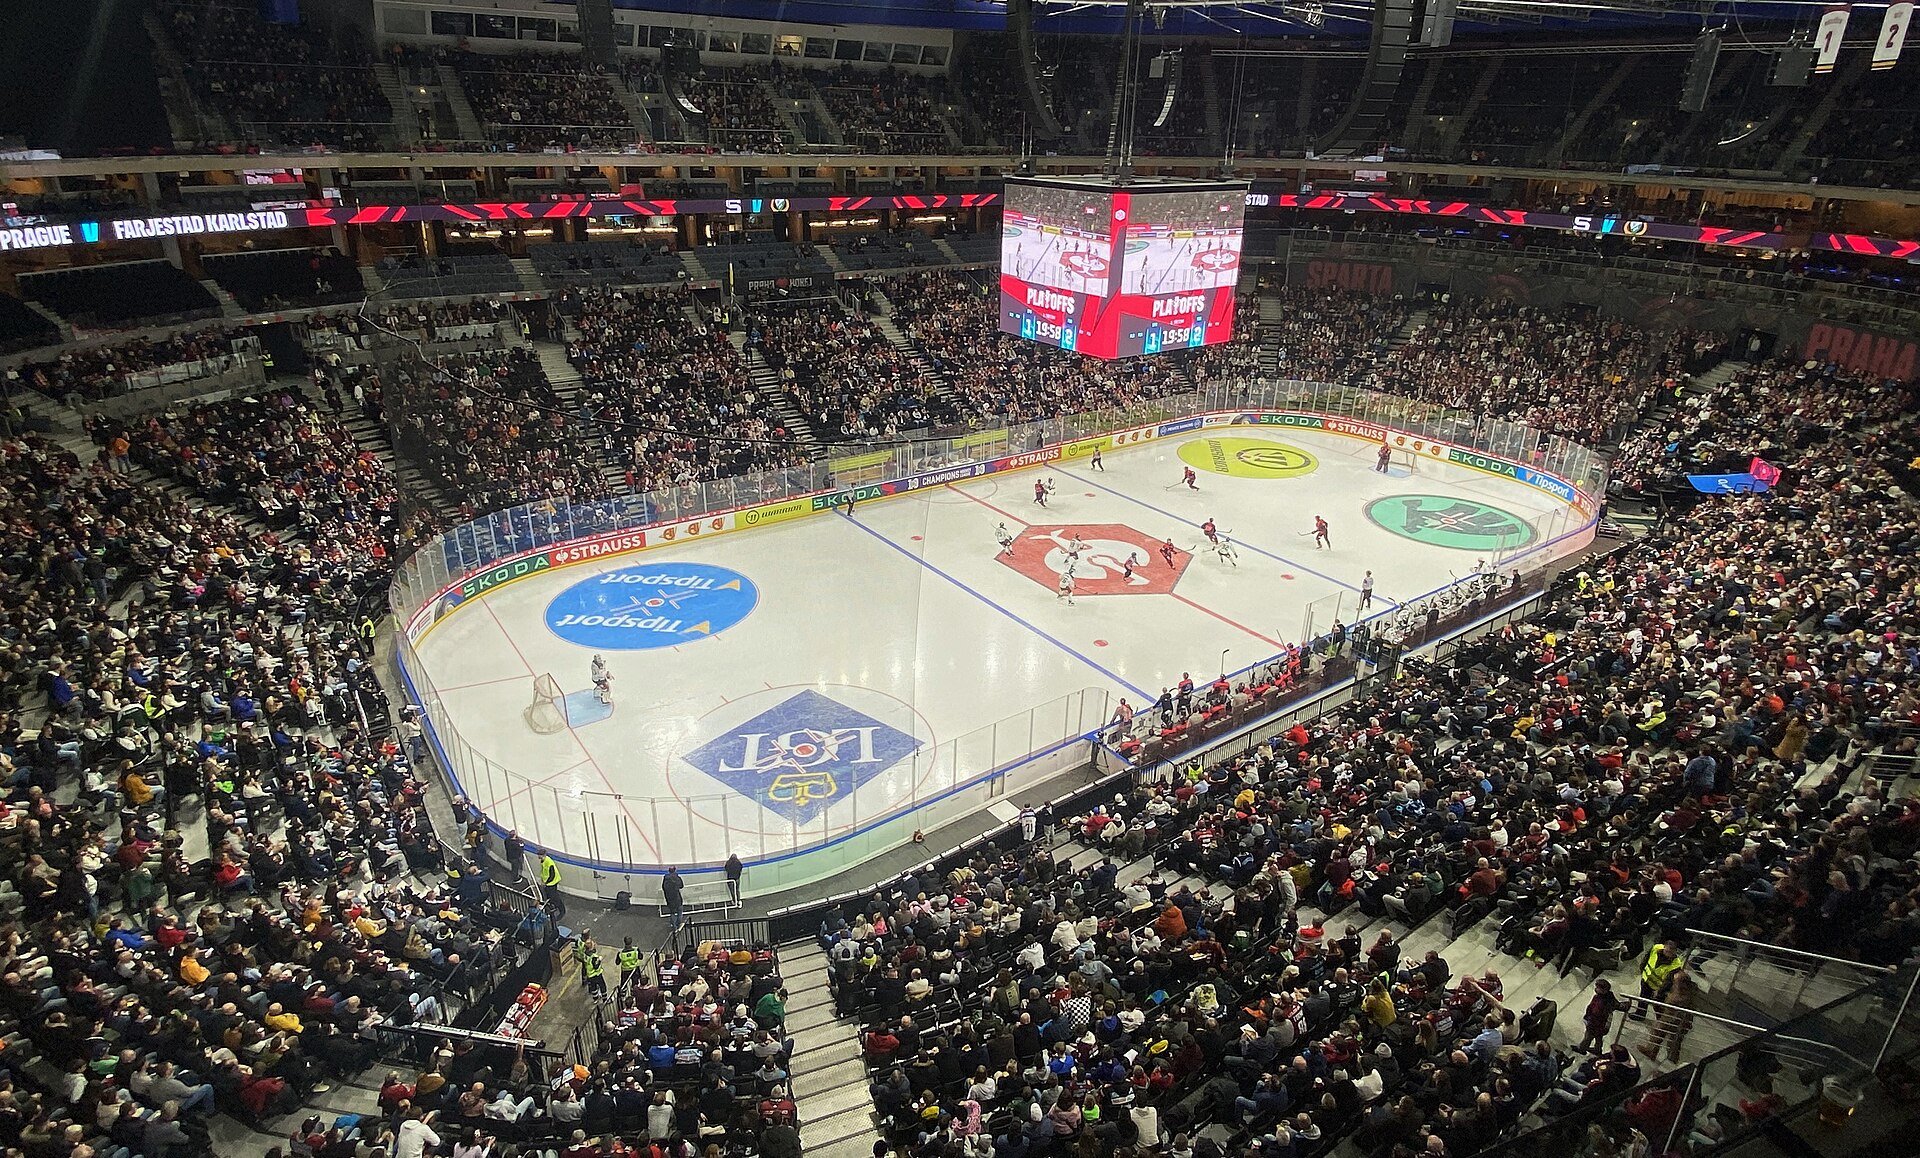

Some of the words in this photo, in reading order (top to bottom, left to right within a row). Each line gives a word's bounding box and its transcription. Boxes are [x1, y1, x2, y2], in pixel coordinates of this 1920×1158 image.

[1824, 30, 1834, 53] 1
[1885, 23, 1900, 49] 2
[0, 224, 73, 250] PRAGUE
[81, 221, 99, 243] V
[112, 213, 205, 241] FARJESTAD
[205, 210, 289, 233] KARLSTAD
[1306, 260, 1392, 294] SPARTA
[1026, 287, 1076, 315] PLAYOFFS
[1152, 294, 1205, 318] PLAYOFFS
[1025, 318, 1032, 336] 1
[1035, 320, 1061, 341] 19:58
[1065, 329, 1073, 346] 2
[1149, 332, 1157, 348] 1
[1161, 327, 1190, 346] 19:58
[1193, 325, 1201, 342] 2
[1804, 322, 1917, 381] PRAHA
[1337, 422, 1384, 441] STRAUSS
[1018, 448, 1059, 467] STRAUSS
[922, 470, 960, 486] CHAMPIONS
[1534, 474, 1569, 498] Tipsport
[571, 535, 642, 561] STRAUSS
[599, 573, 715, 590] Tipsport
[556, 614, 682, 633] Tipsport
